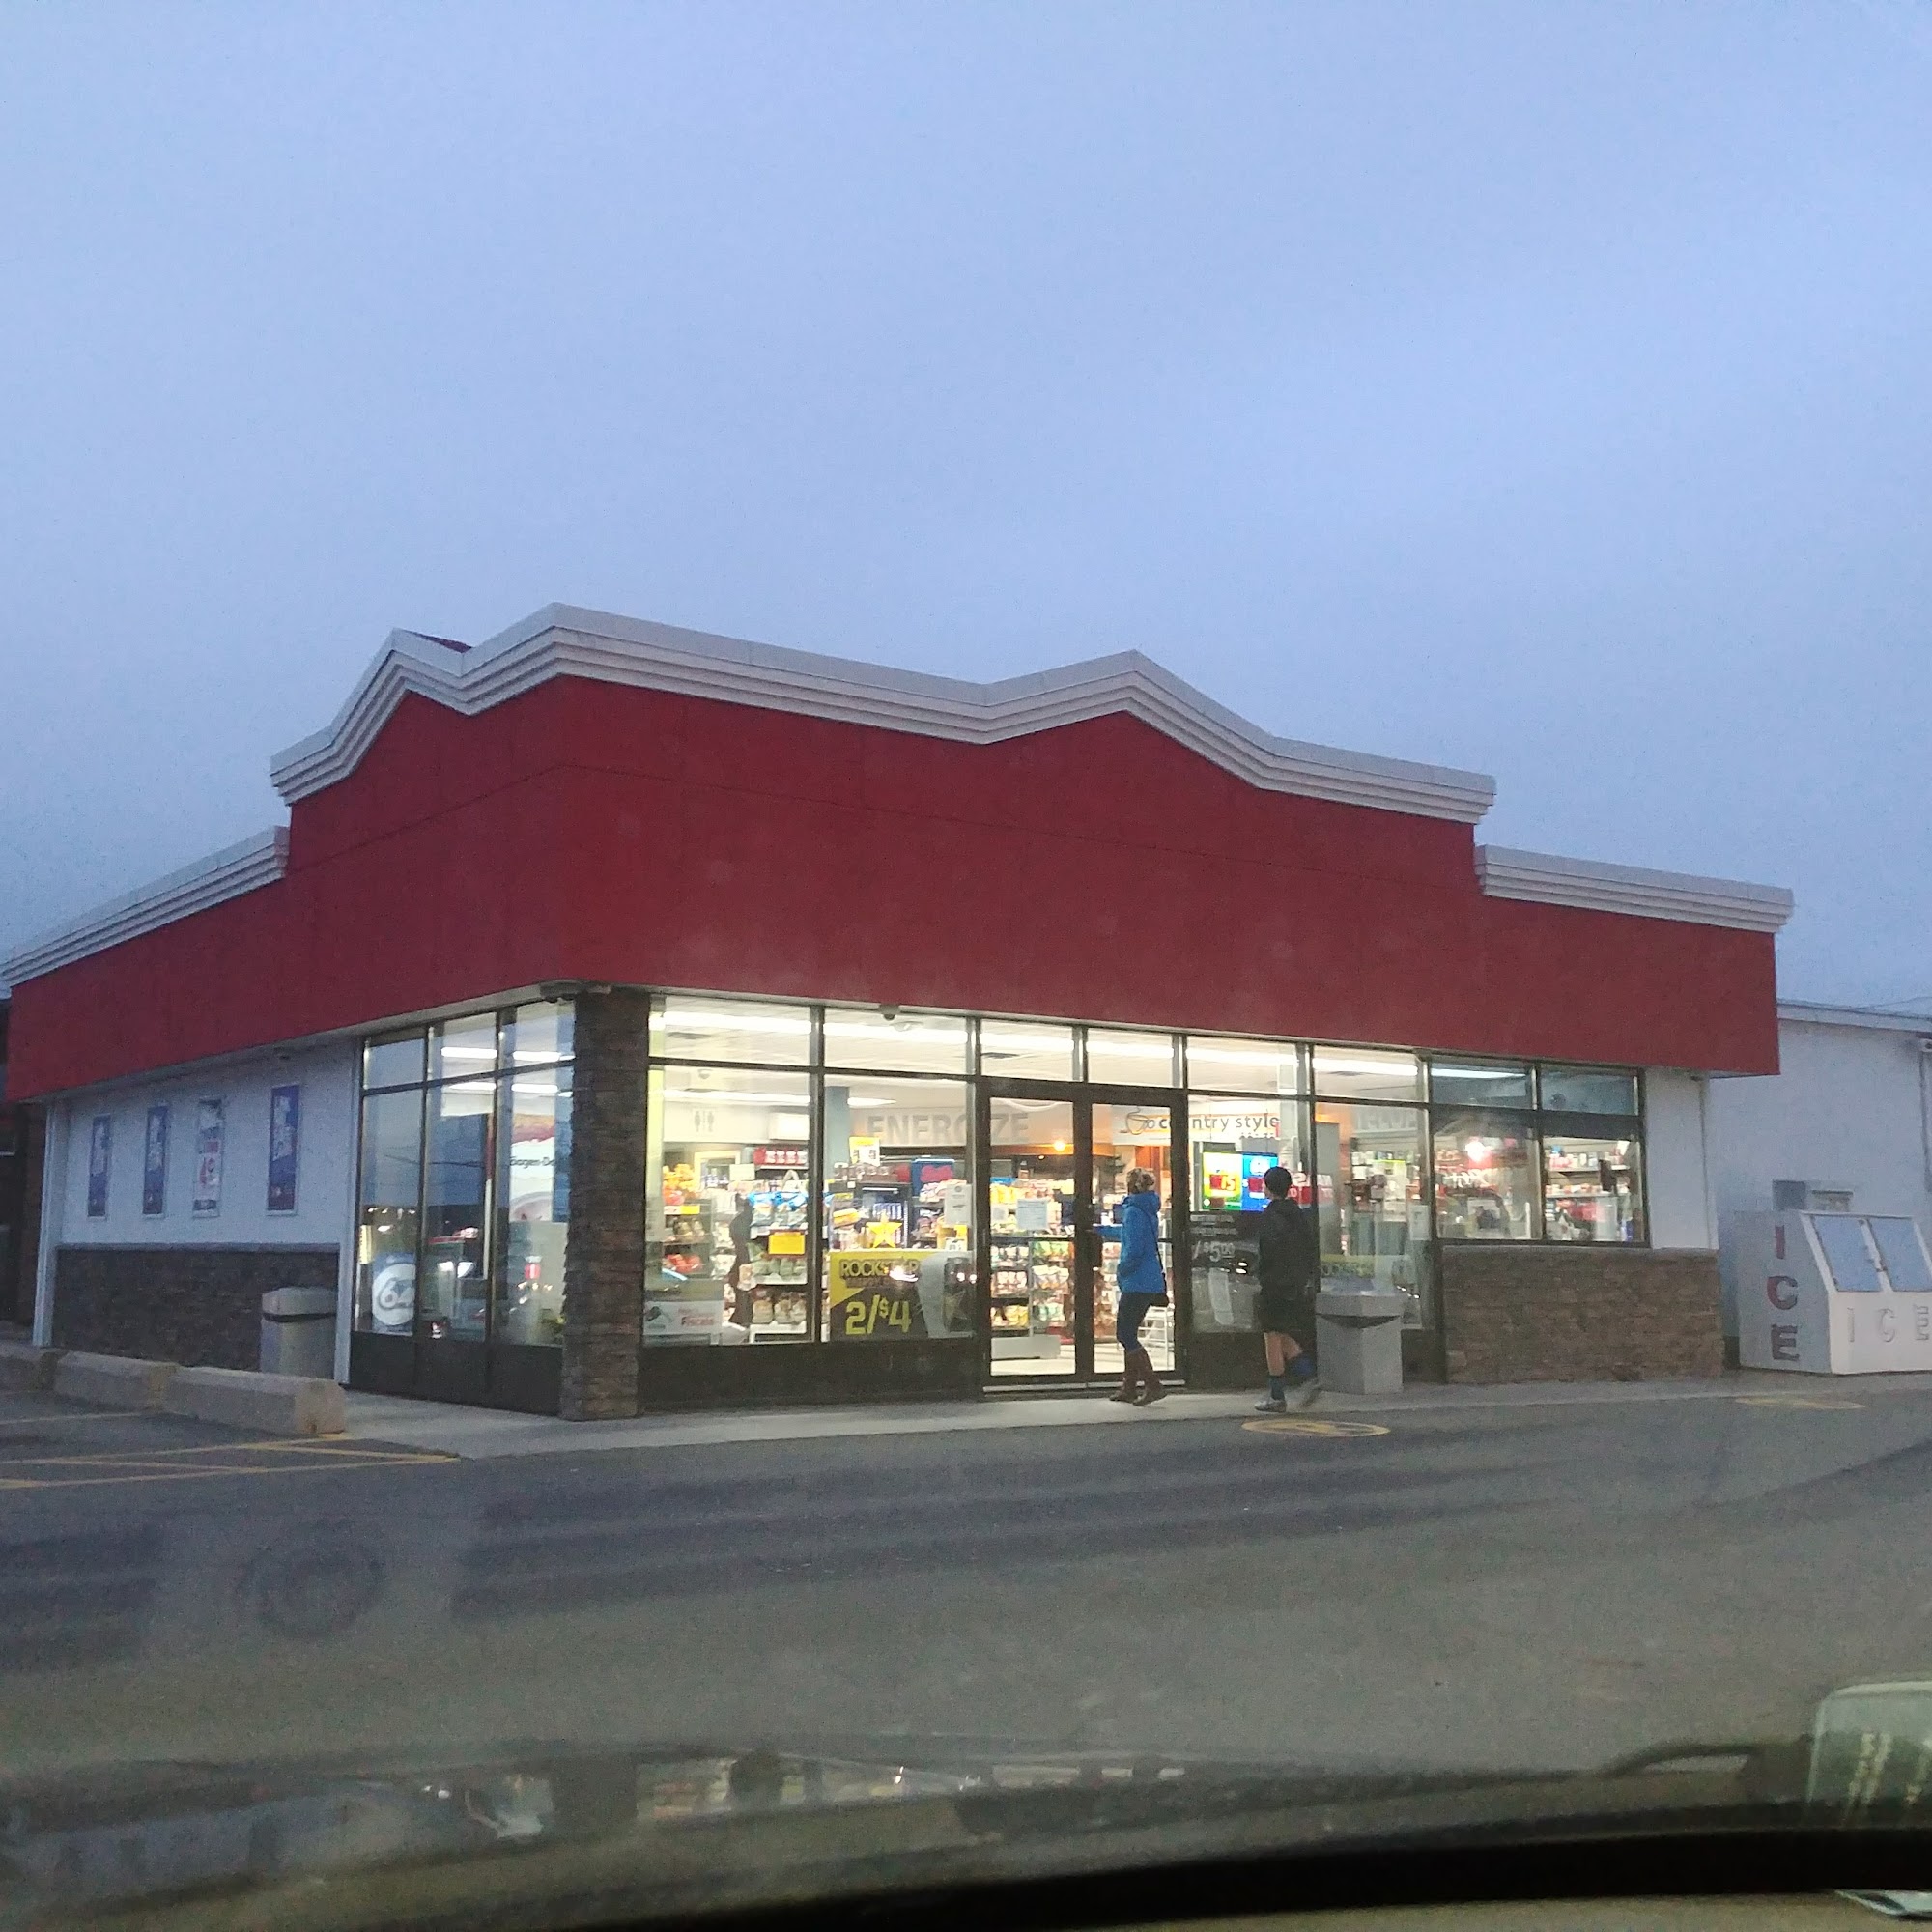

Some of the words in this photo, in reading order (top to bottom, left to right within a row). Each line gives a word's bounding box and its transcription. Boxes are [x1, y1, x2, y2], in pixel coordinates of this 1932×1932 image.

[867, 1112, 1029, 1147] ENERZE
[1158, 1114, 1229, 1132] cntry
[1236, 1112, 1281, 1131] style
[838, 1259, 920, 1277] ROCKSTR
[1766, 1224, 1801, 1361] ICE
[845, 1294, 912, 1335] 2/$4
[1846, 1305, 1930, 1343] ICE
